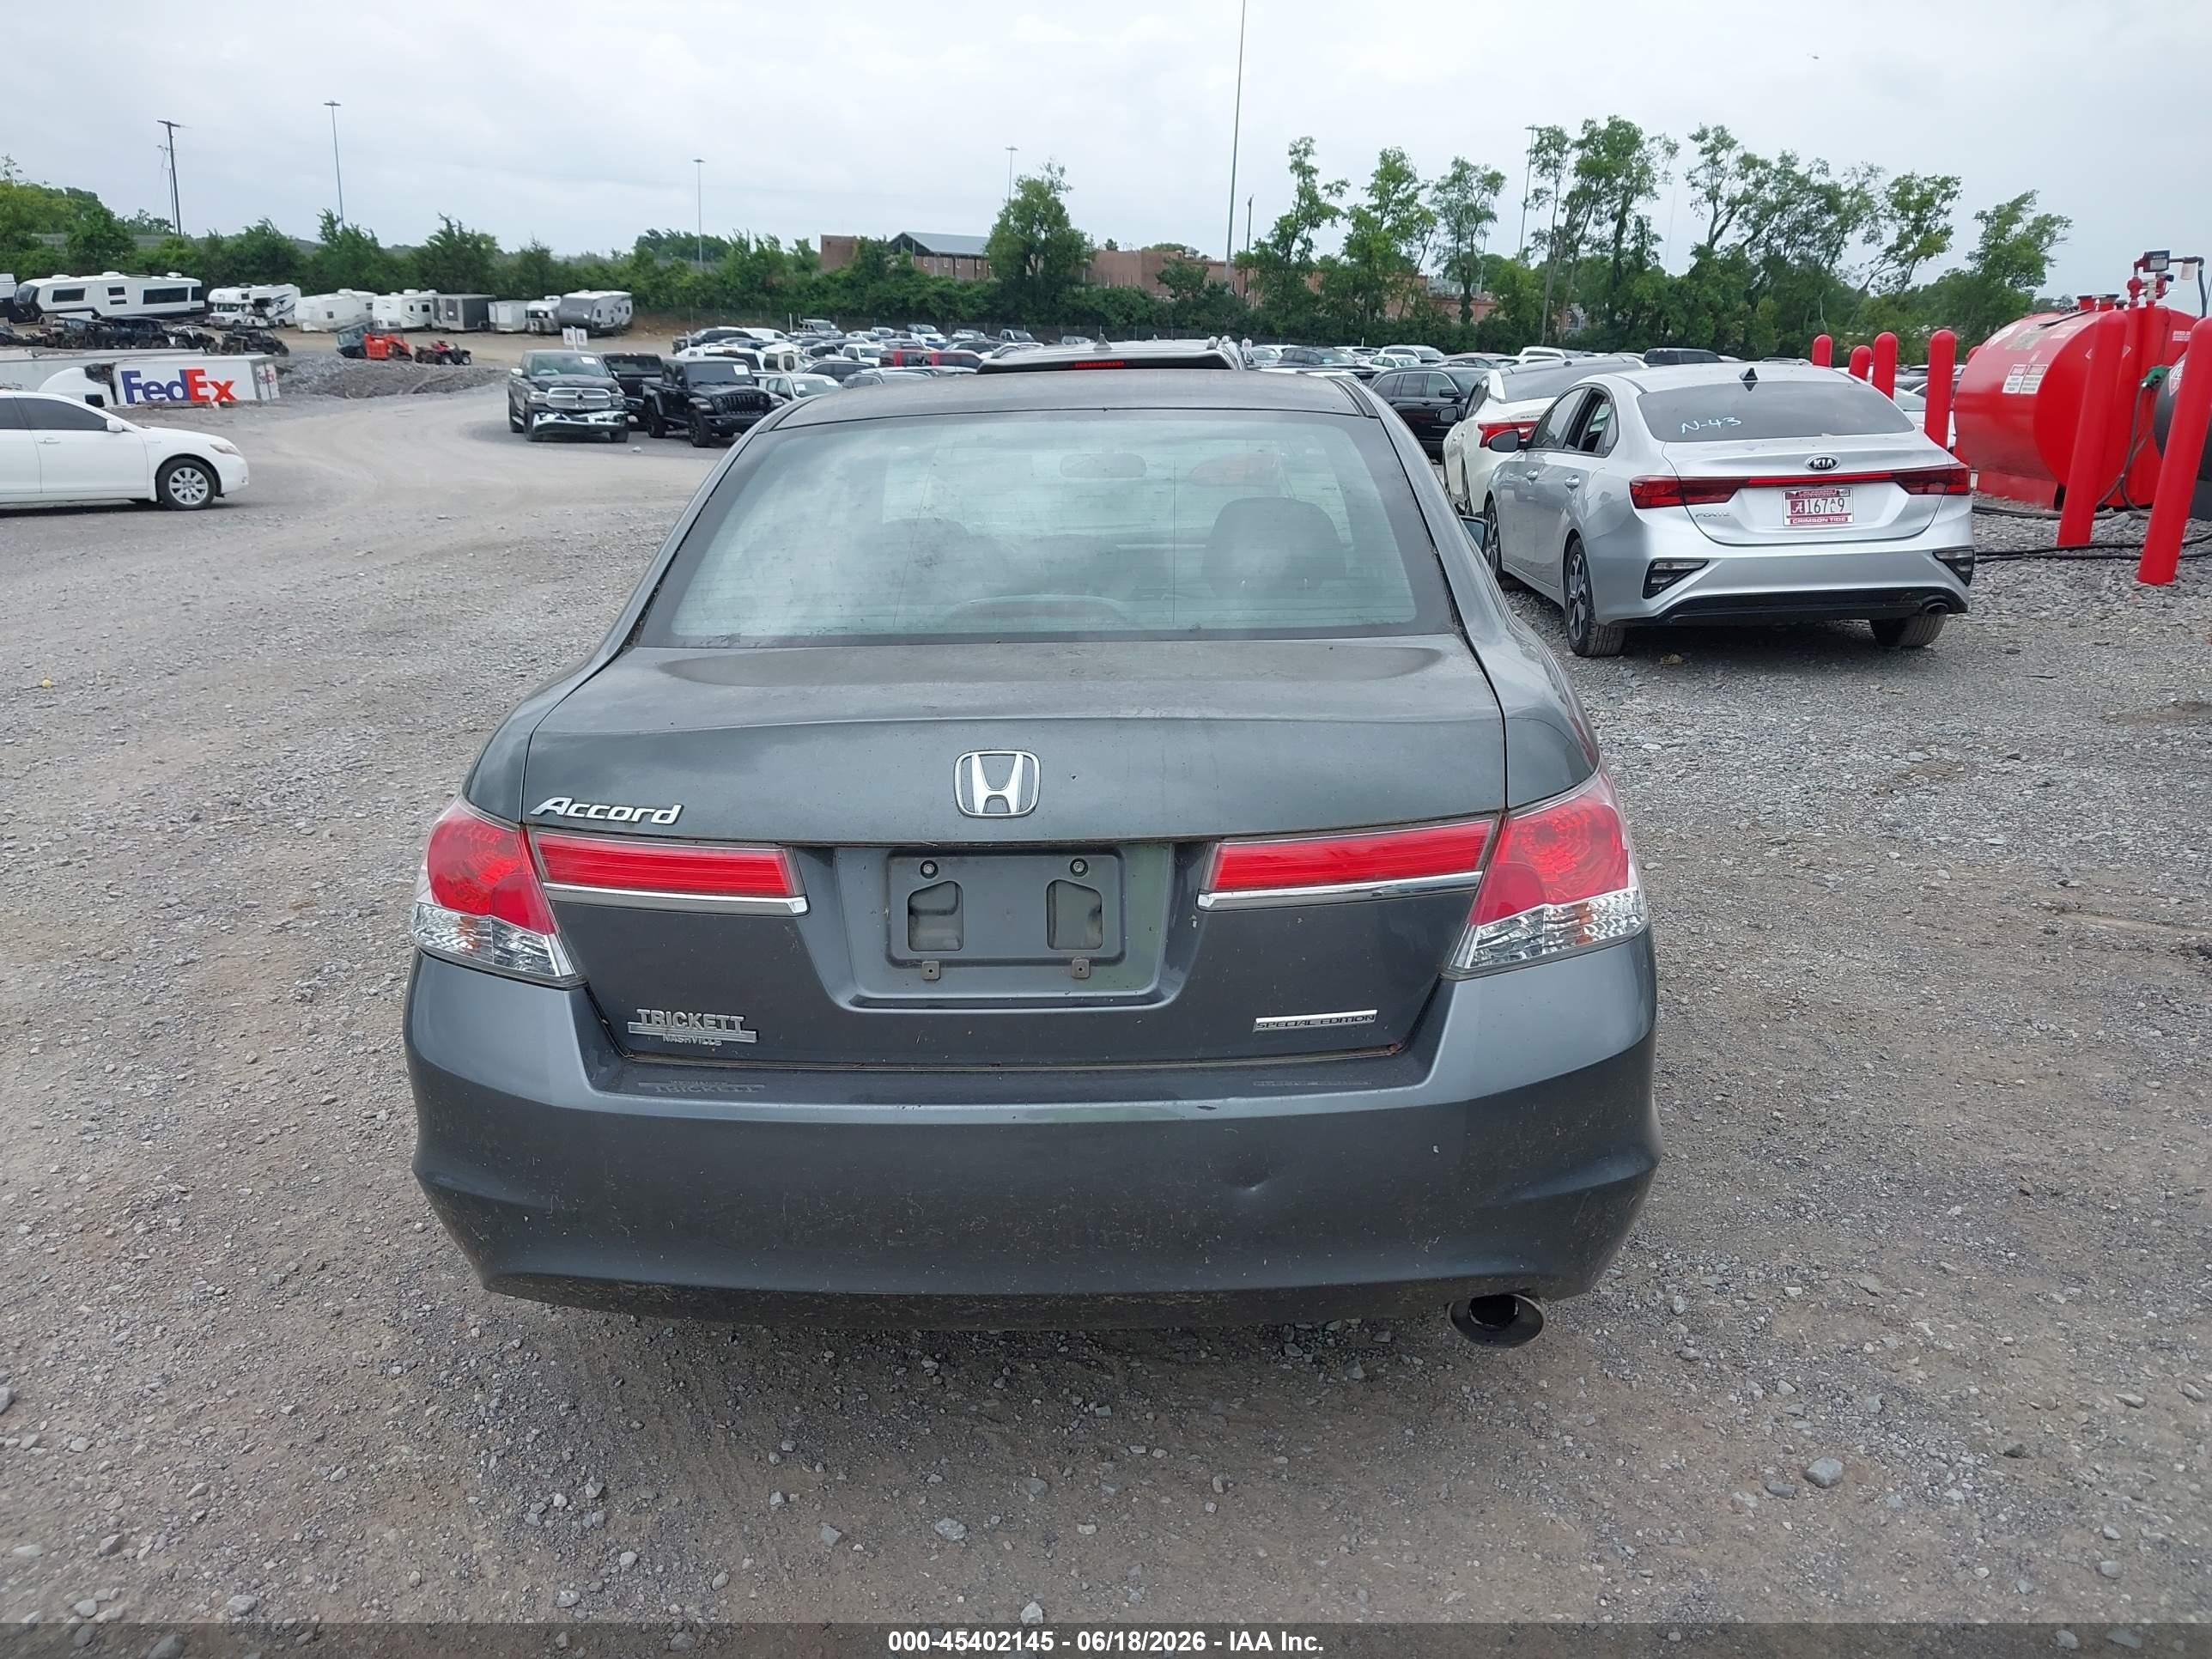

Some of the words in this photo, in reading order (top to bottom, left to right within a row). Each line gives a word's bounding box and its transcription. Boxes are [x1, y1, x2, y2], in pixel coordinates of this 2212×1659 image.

[120, 368, 238, 404] FedEx
[1681, 416, 1742, 434] N-43
[1813, 458, 1835, 468] KIA
[529, 796, 684, 825] Accord
[636, 1008, 744, 1034] TRICKETT
[1256, 1019, 1316, 1029] SPECIAL
[1320, 1014, 1375, 1025] EDITION
[662, 1033, 723, 1047] NASHVILLE
